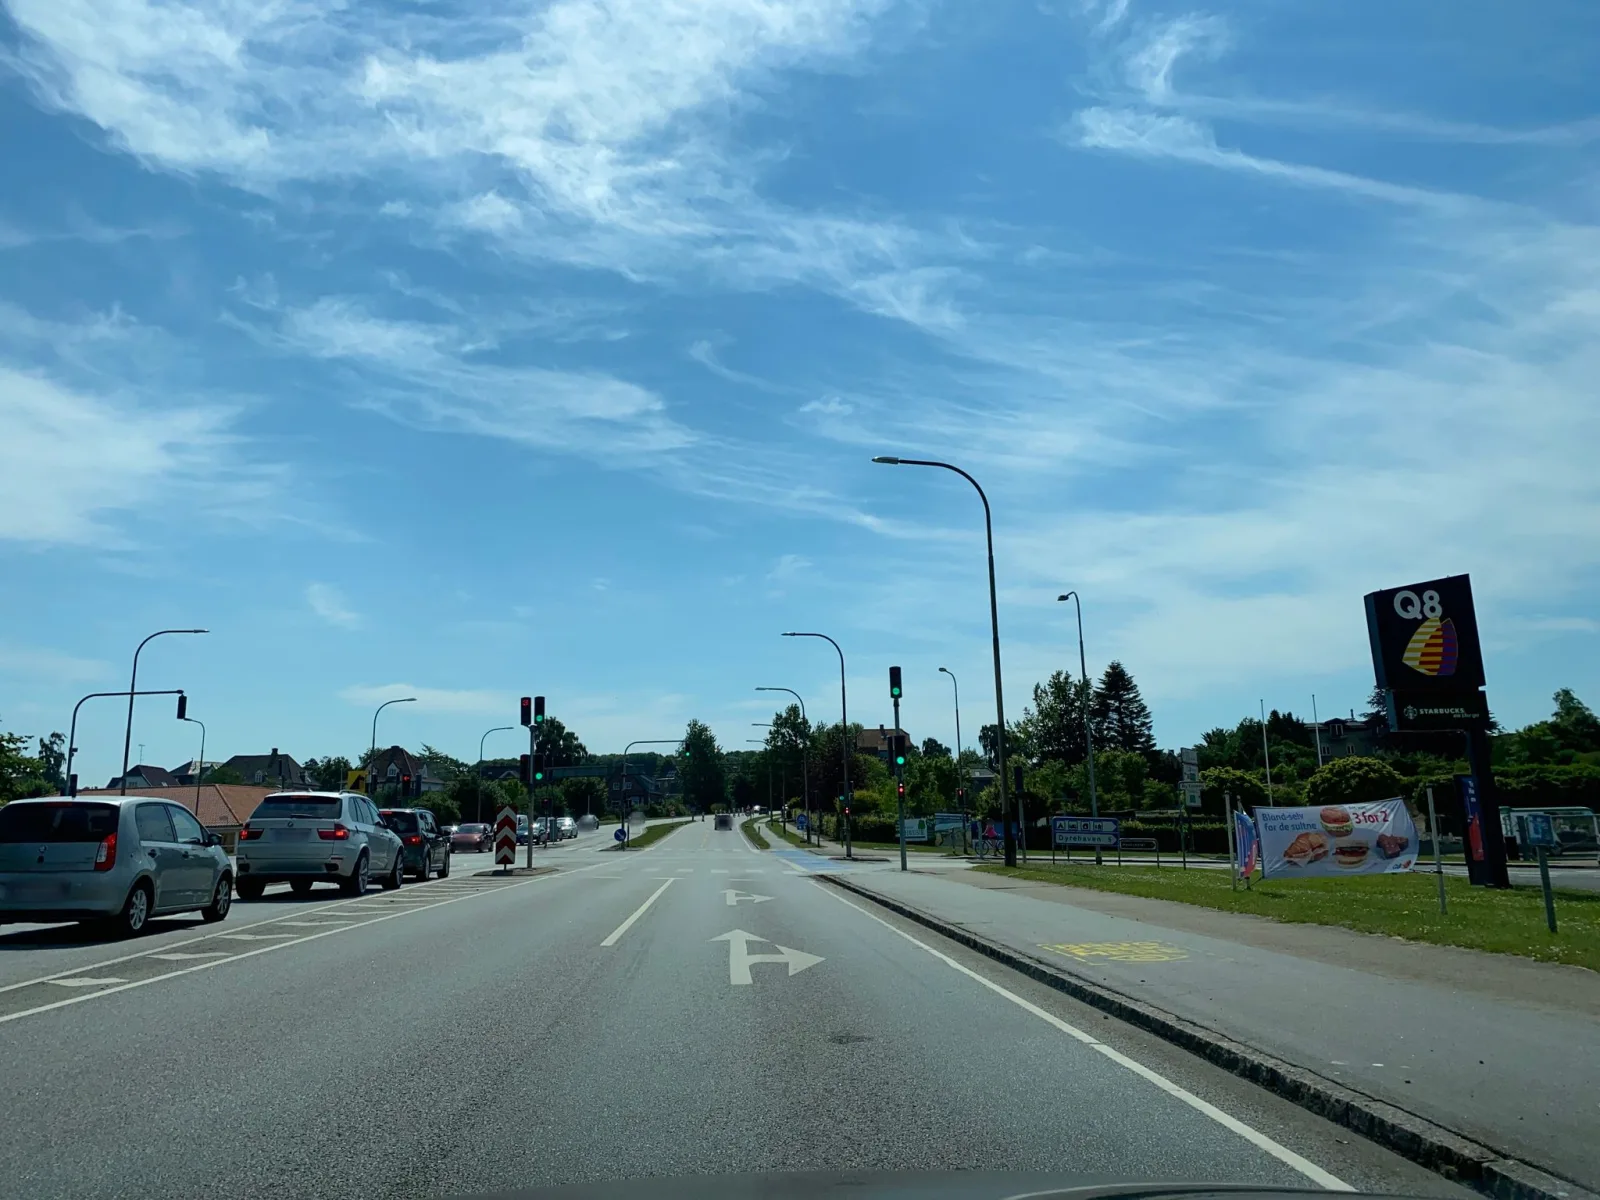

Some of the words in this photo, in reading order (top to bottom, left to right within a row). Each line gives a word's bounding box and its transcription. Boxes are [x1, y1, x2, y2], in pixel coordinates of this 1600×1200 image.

[1394, 590, 1442, 619] Q8
[1262, 812, 1304, 822] Bland-selv
[1353, 812, 1362, 824] 3
[1362, 811, 1380, 824] for
[1380, 810, 1389, 822] 2
[1264, 823, 1276, 832] for
[1279, 822, 1289, 831] de
[1291, 821, 1317, 831] sultne
[1058, 834, 1102, 842] Dyrehaven
